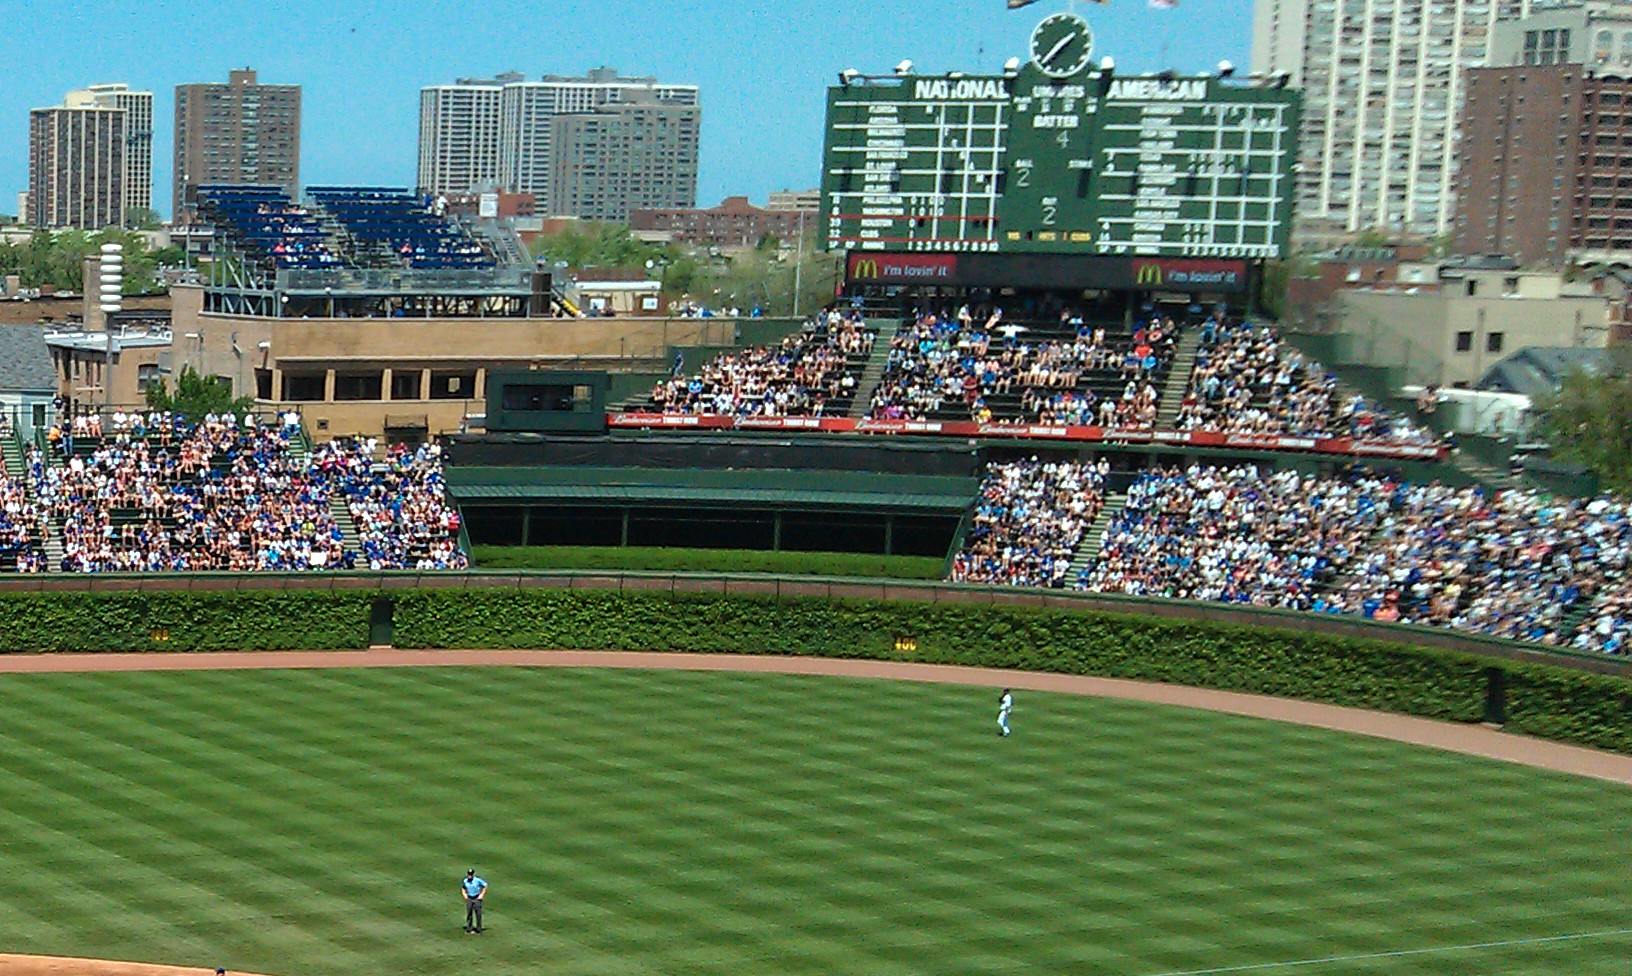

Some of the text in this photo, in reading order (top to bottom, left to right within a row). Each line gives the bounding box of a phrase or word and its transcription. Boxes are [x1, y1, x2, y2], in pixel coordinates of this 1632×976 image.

[915, 80, 1010, 99] NATIONAL
[1106, 80, 1207, 99] AMERICAN
[1033, 114, 1079, 128] BATTER
[1056, 130, 1069, 149] 4
[1017, 168, 1030, 187] 2
[1042, 206, 1057, 225] 2
